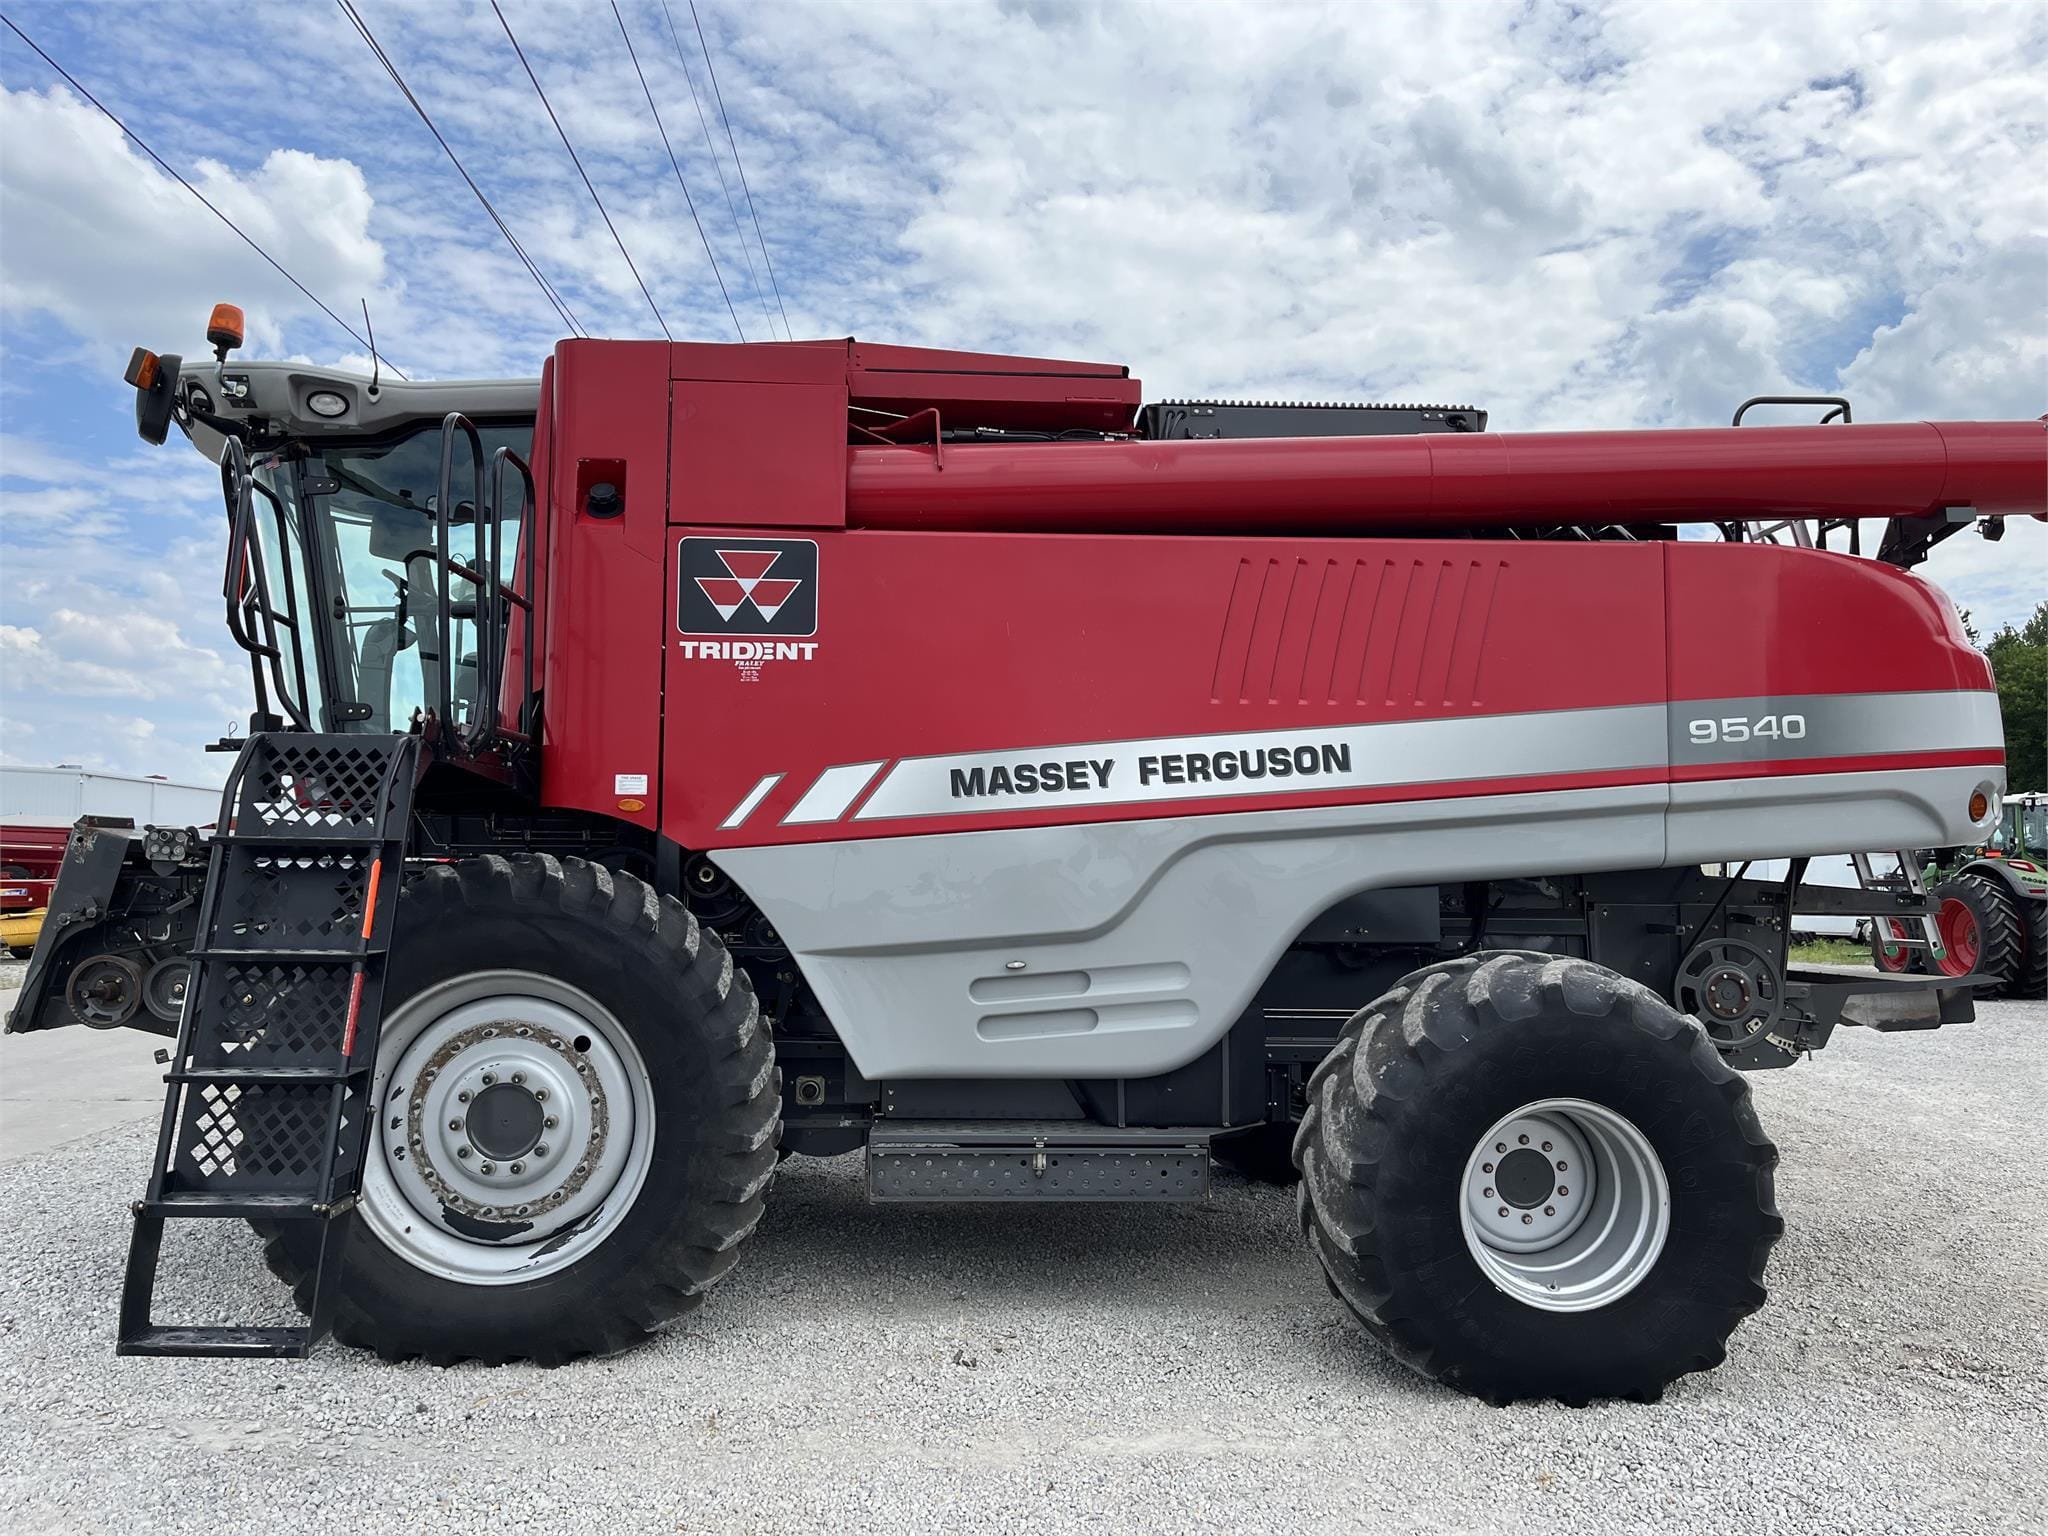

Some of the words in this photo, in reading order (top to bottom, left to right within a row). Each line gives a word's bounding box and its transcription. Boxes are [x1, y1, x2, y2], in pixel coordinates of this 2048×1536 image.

[679, 641, 819, 661] TRIDENT
[1688, 714, 1806, 744] 9540
[950, 758, 1115, 799] MASSEY
[1138, 743, 1352, 786] FERGUSON
